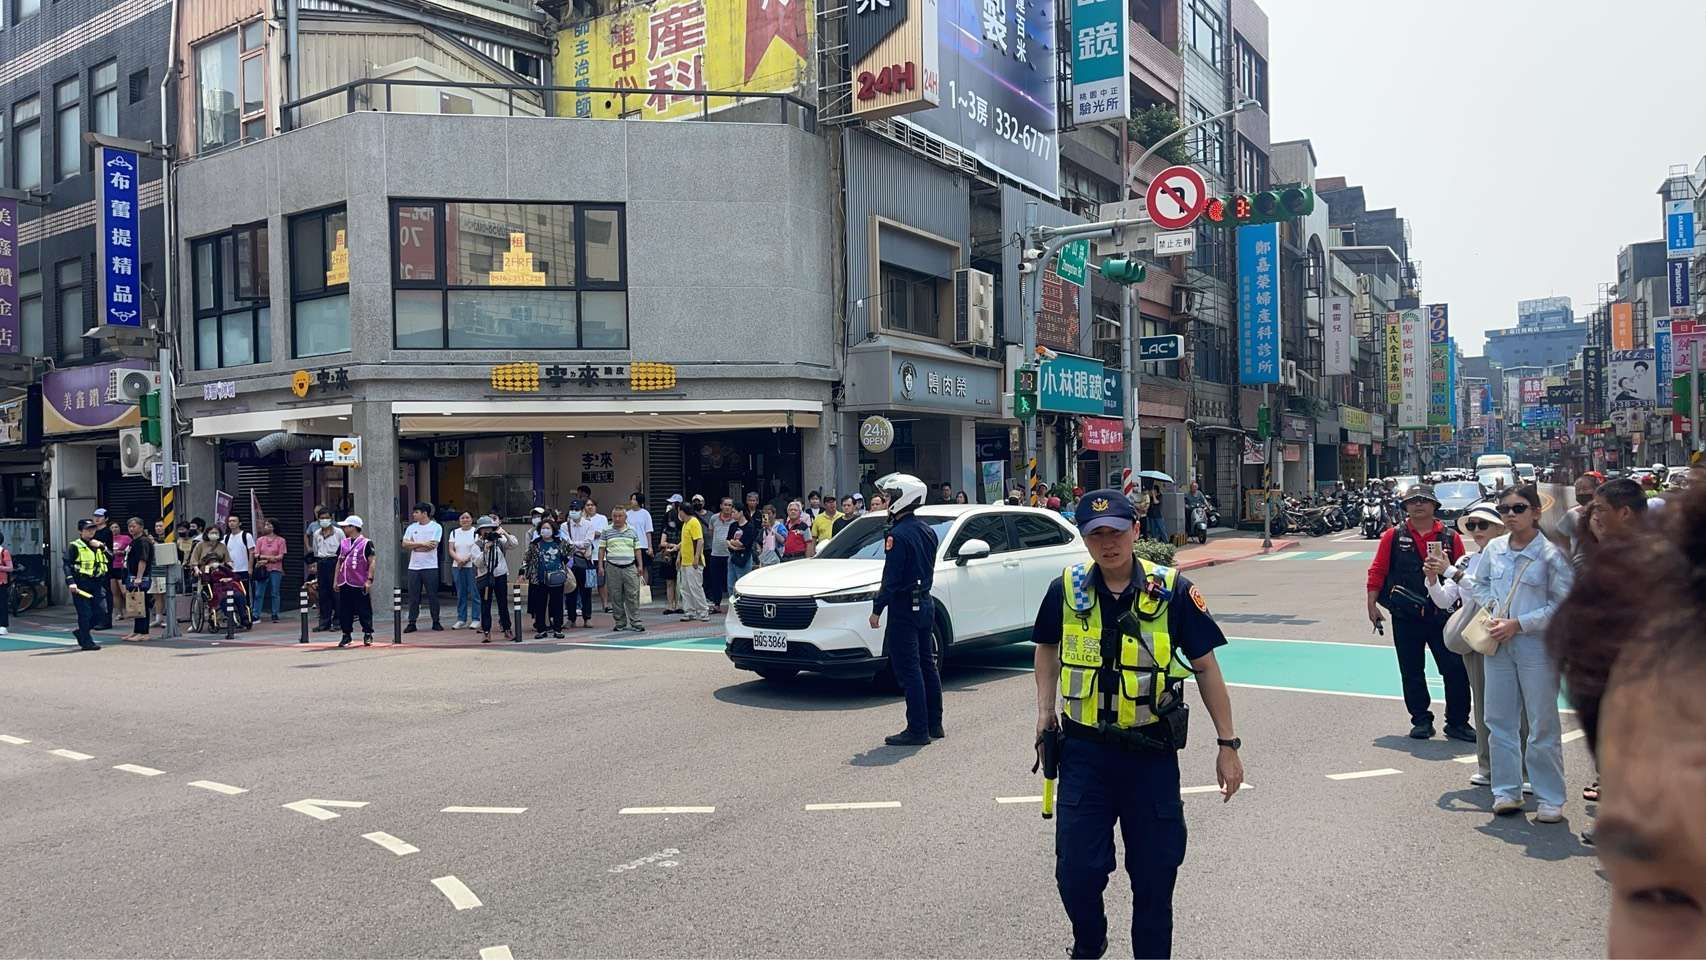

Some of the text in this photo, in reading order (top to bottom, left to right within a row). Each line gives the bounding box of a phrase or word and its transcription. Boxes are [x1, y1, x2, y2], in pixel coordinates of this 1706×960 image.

[857, 61, 915, 100] 24H
[1079, 97, 1120, 117] 驗光所
[996, 108, 1051, 161] 332-6777
[109, 171, 134, 304] 布蕾提精品
[1159, 237, 1191, 249] 禁止左轉
[1674, 262, 1684, 304] Panasonic
[927, 371, 967, 398] 鴨肉榮
[1042, 366, 1103, 401] 小林眼鏡
[863, 437, 887, 446] OPEN
[1064, 652, 1101, 663] POLICE
